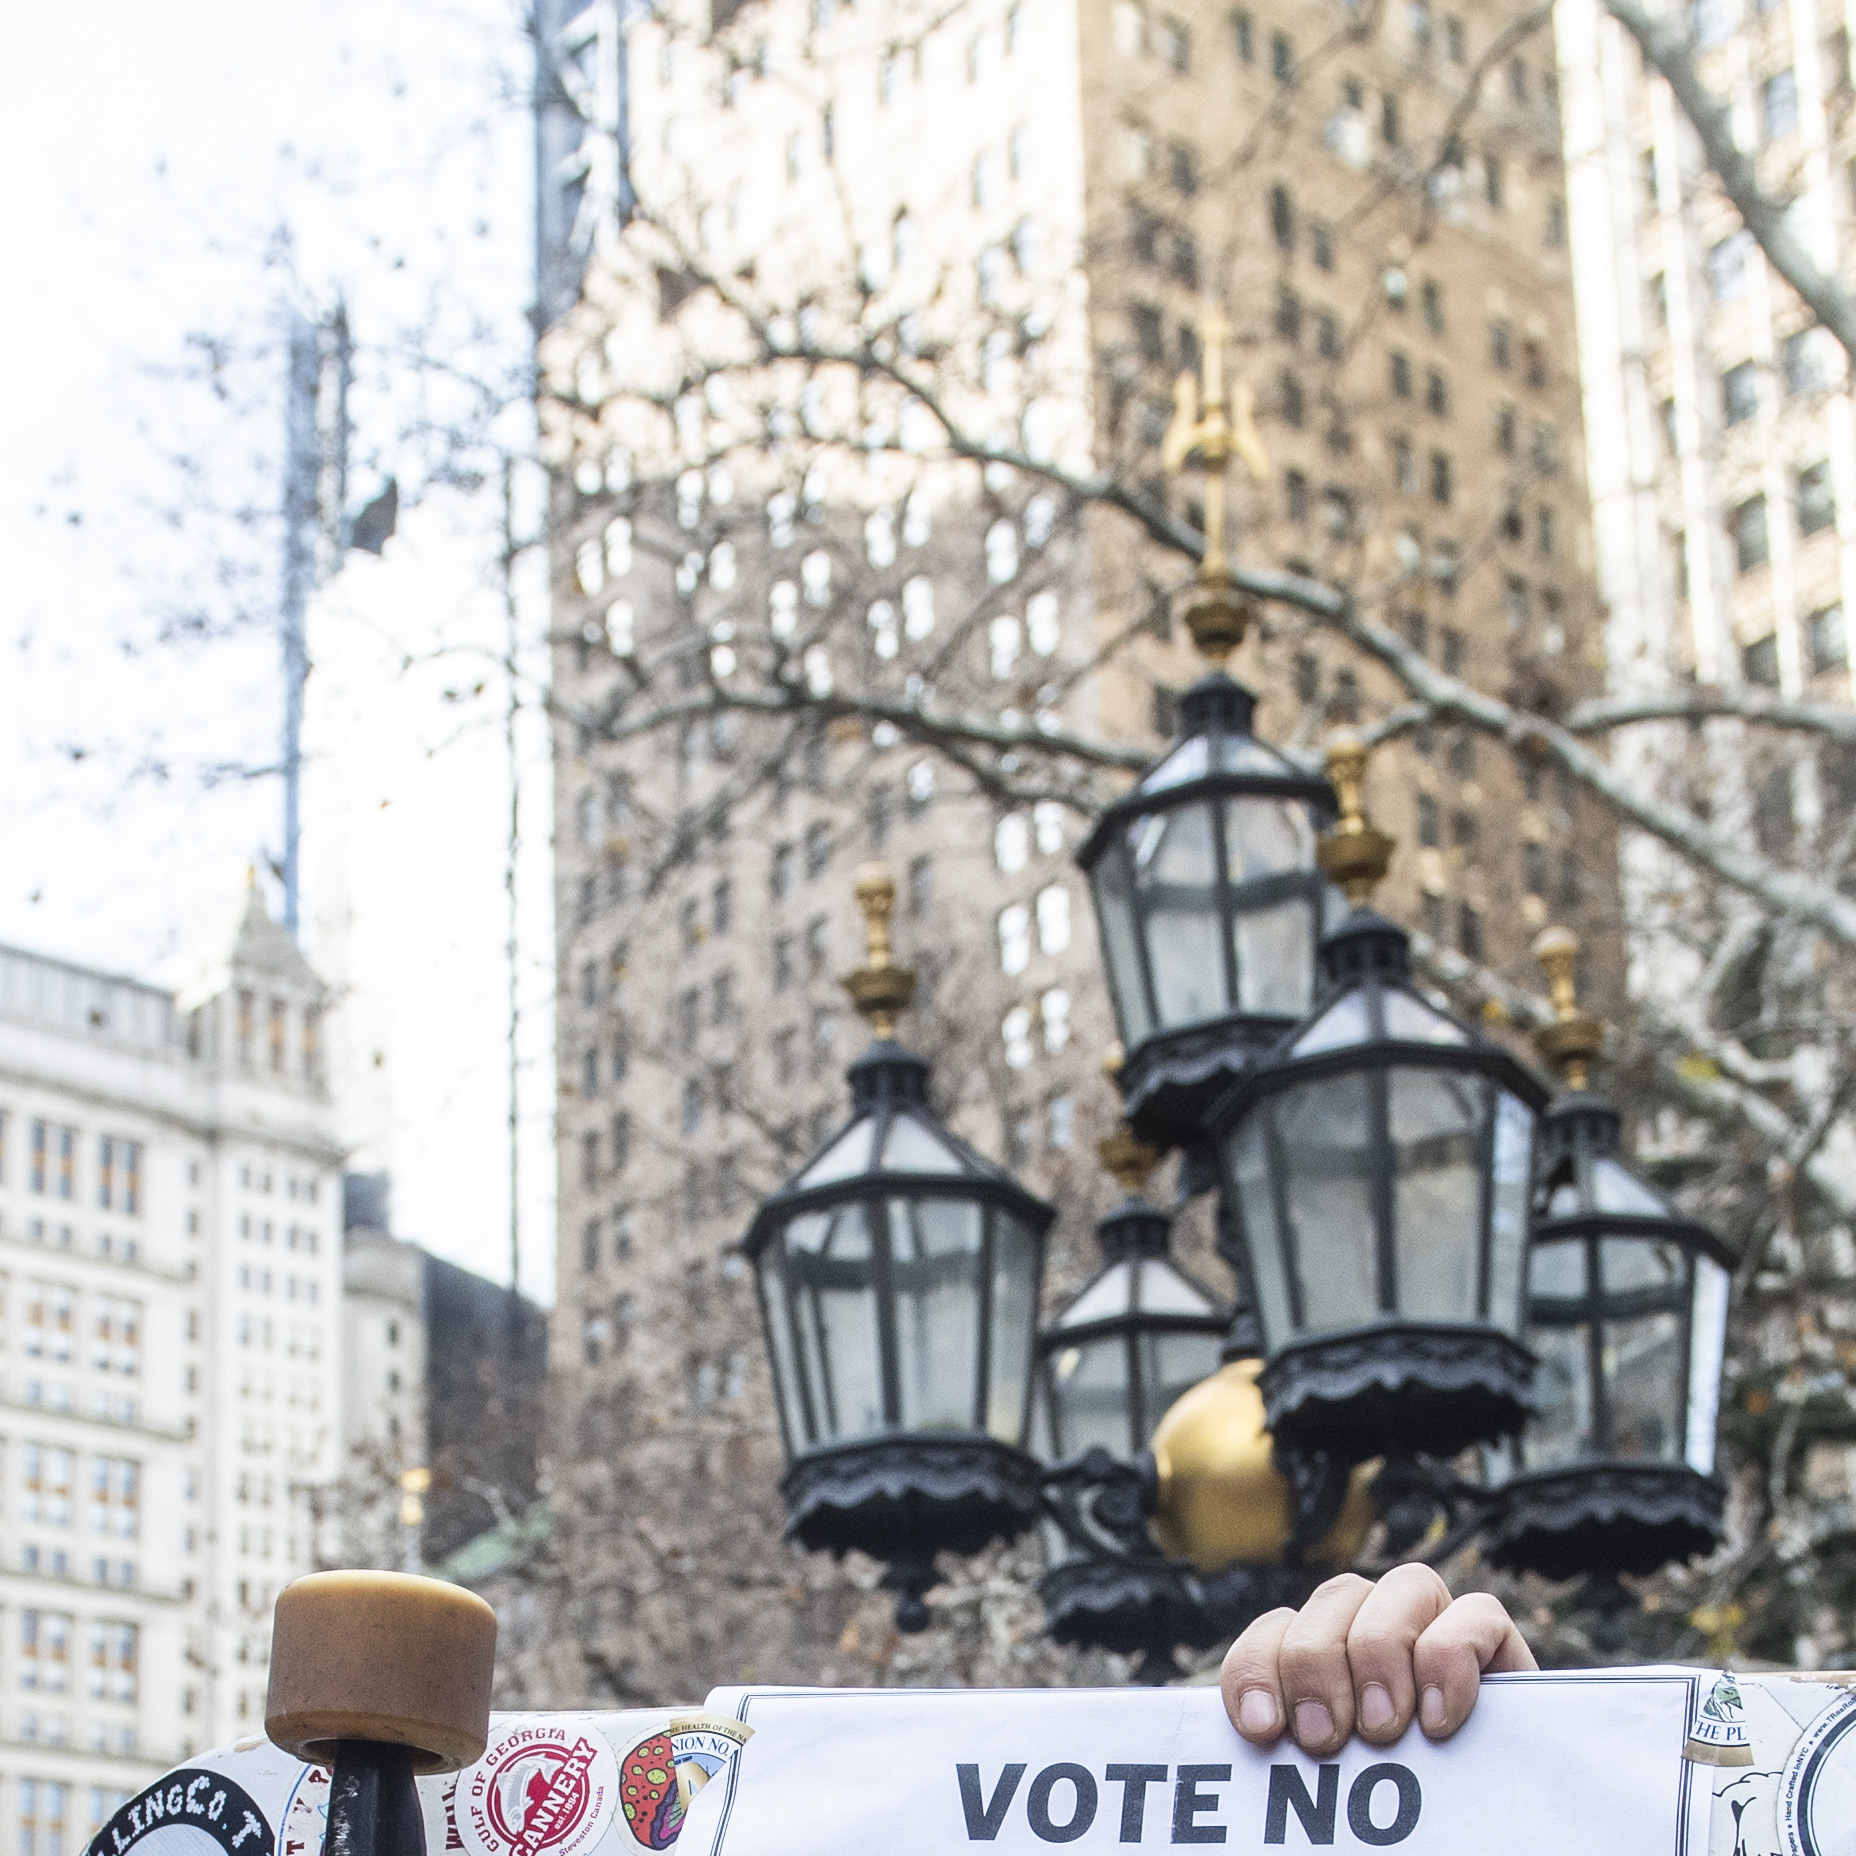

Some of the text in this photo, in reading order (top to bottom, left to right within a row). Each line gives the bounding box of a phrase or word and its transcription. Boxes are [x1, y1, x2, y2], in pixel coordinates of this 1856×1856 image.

[681, 1723, 711, 1731] HEALTH
[707, 1738, 730, 1757] NO.
[470, 1727, 567, 1853] GULF OF GEORGIA
[589, 1785, 605, 1819] Canada
[954, 1762, 1423, 1847] VOTE NO
